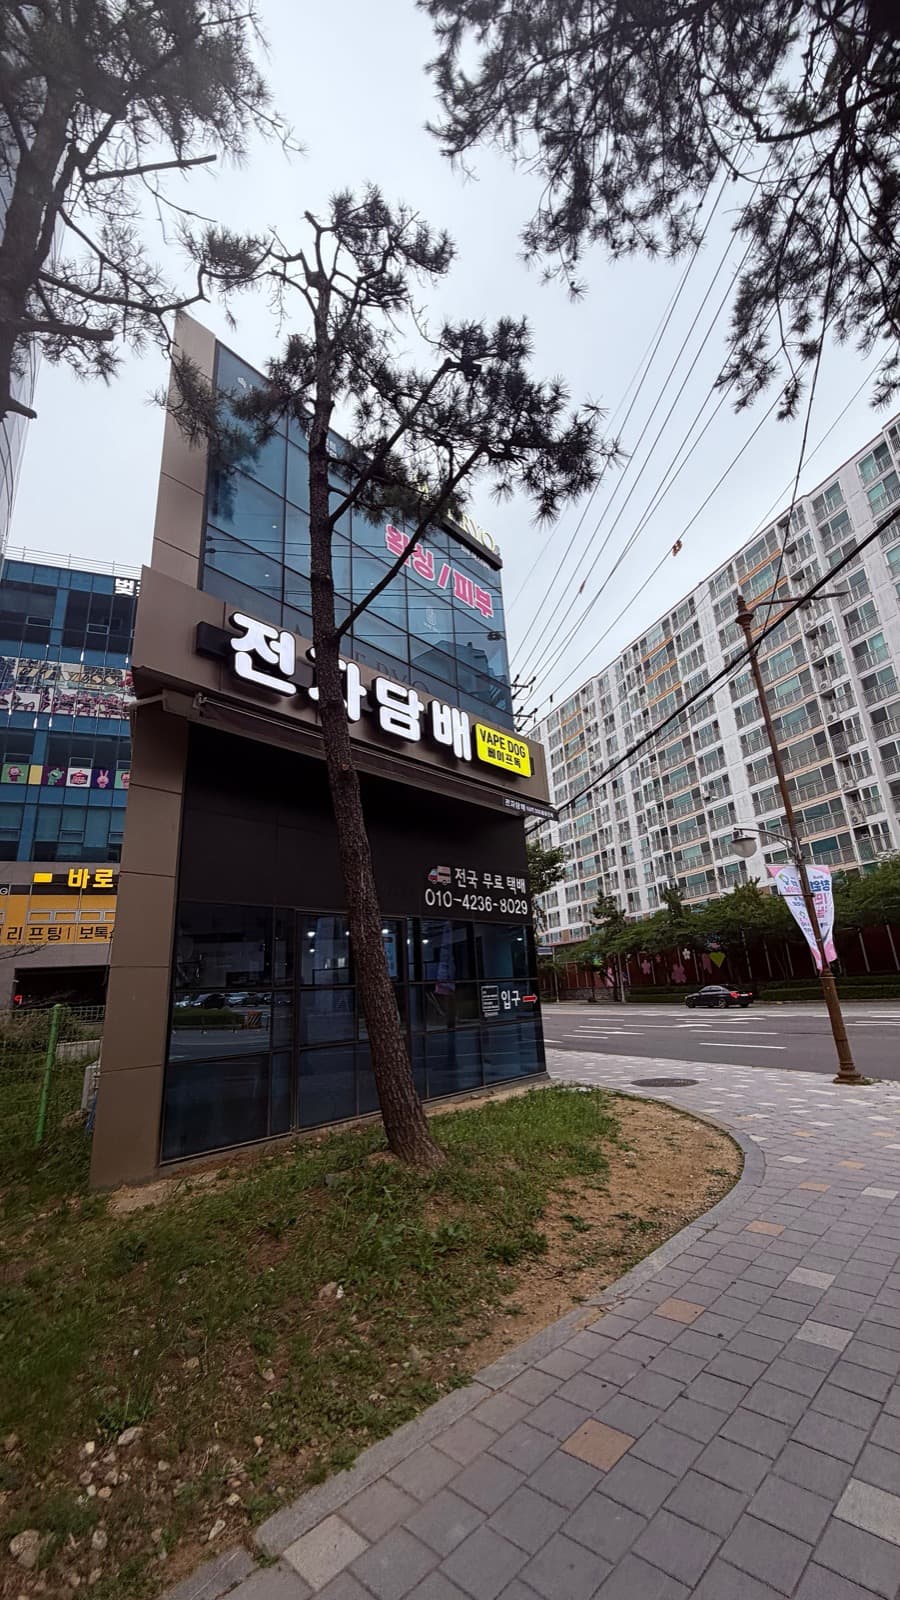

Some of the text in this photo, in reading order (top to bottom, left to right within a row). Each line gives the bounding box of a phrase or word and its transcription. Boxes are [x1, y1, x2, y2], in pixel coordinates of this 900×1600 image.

[479, 728, 526, 759] VAPE DOG
[67, 867, 114, 889] 바로
[454, 868, 526, 895] 전국 무료 택배
[425, 888, 528, 915] 010-4236-8029
[79, 926, 114, 940] 보톡
[501, 990, 521, 1010] 입구
